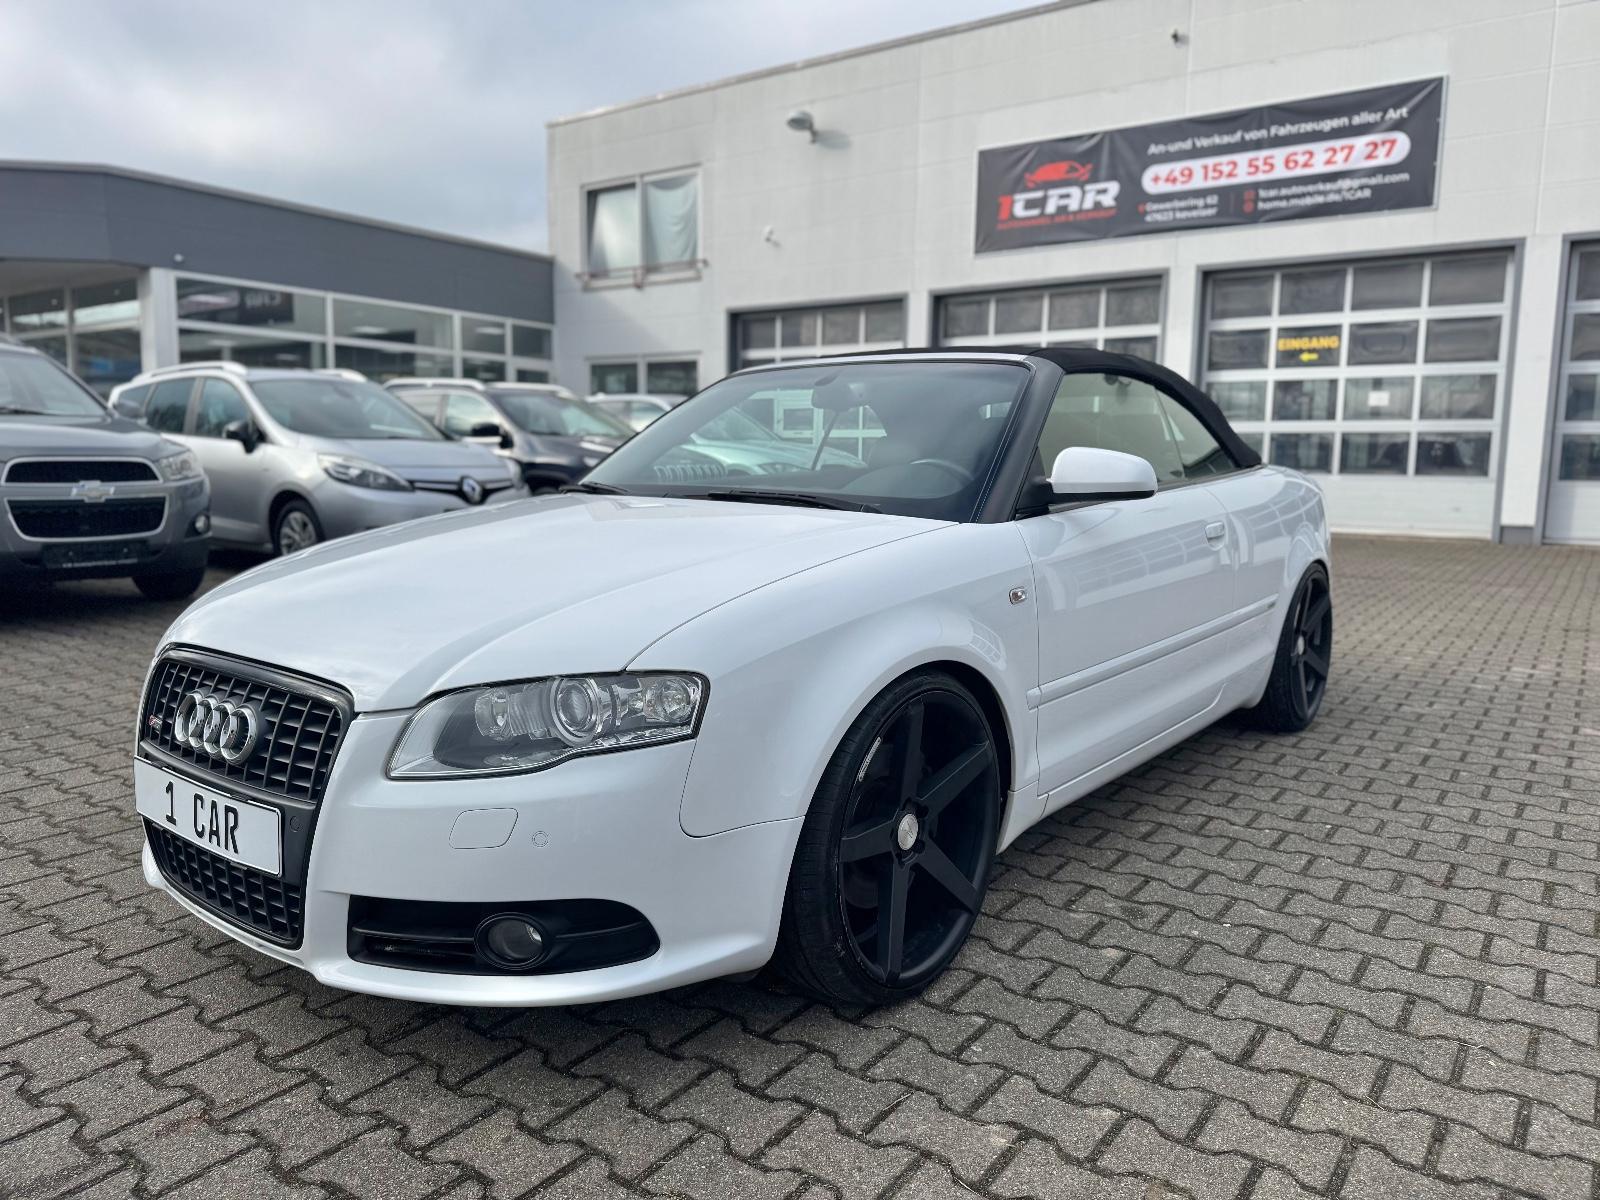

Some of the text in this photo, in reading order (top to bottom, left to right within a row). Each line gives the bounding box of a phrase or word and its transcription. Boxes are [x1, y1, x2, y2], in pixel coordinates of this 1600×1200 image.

[1194, 129, 1242, 148] Verkauf
[1244, 128, 1268, 141] von
[1269, 116, 1350, 138] Fahrzeugen
[1351, 111, 1383, 126] aller
[1384, 106, 1408, 121] Art
[1151, 138, 1398, 185] +49 152 55 62 27 27
[1278, 335, 1340, 352] EINGANG
[165, 780, 239, 854] 1 CAR
